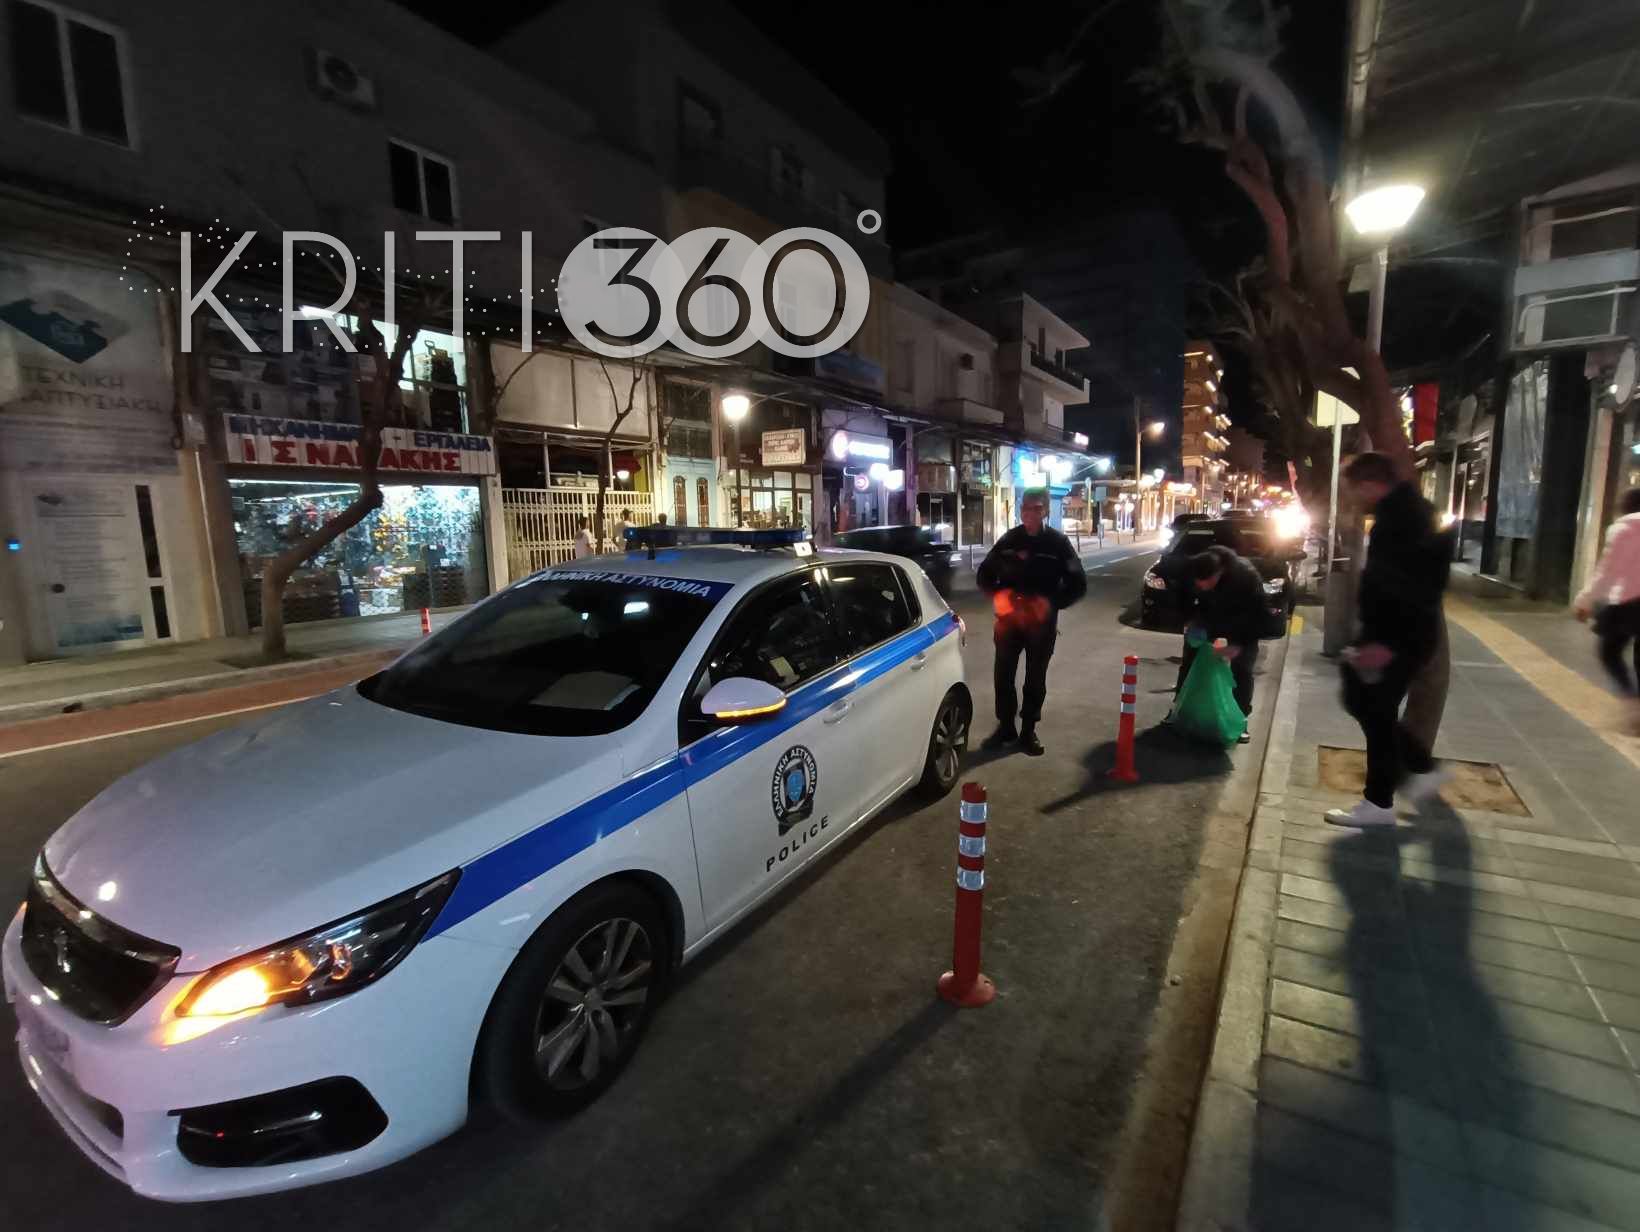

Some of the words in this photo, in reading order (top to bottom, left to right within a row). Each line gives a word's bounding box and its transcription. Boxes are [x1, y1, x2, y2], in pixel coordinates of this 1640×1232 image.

[21, 366, 125, 388] ΤΕΧΝΙΚΗ
[20, 389, 163, 412] ΑΠΤΥΞΙΑΚΗ
[415, 432, 491, 452] ΕΡΓΑΛΕΙΑ
[306, 442, 460, 471] ΝΑΑΚΗΣ
[606, 572, 712, 597] ΑΣΤΥΝΟΜΙΑ
[766, 815, 829, 872] POLICE
